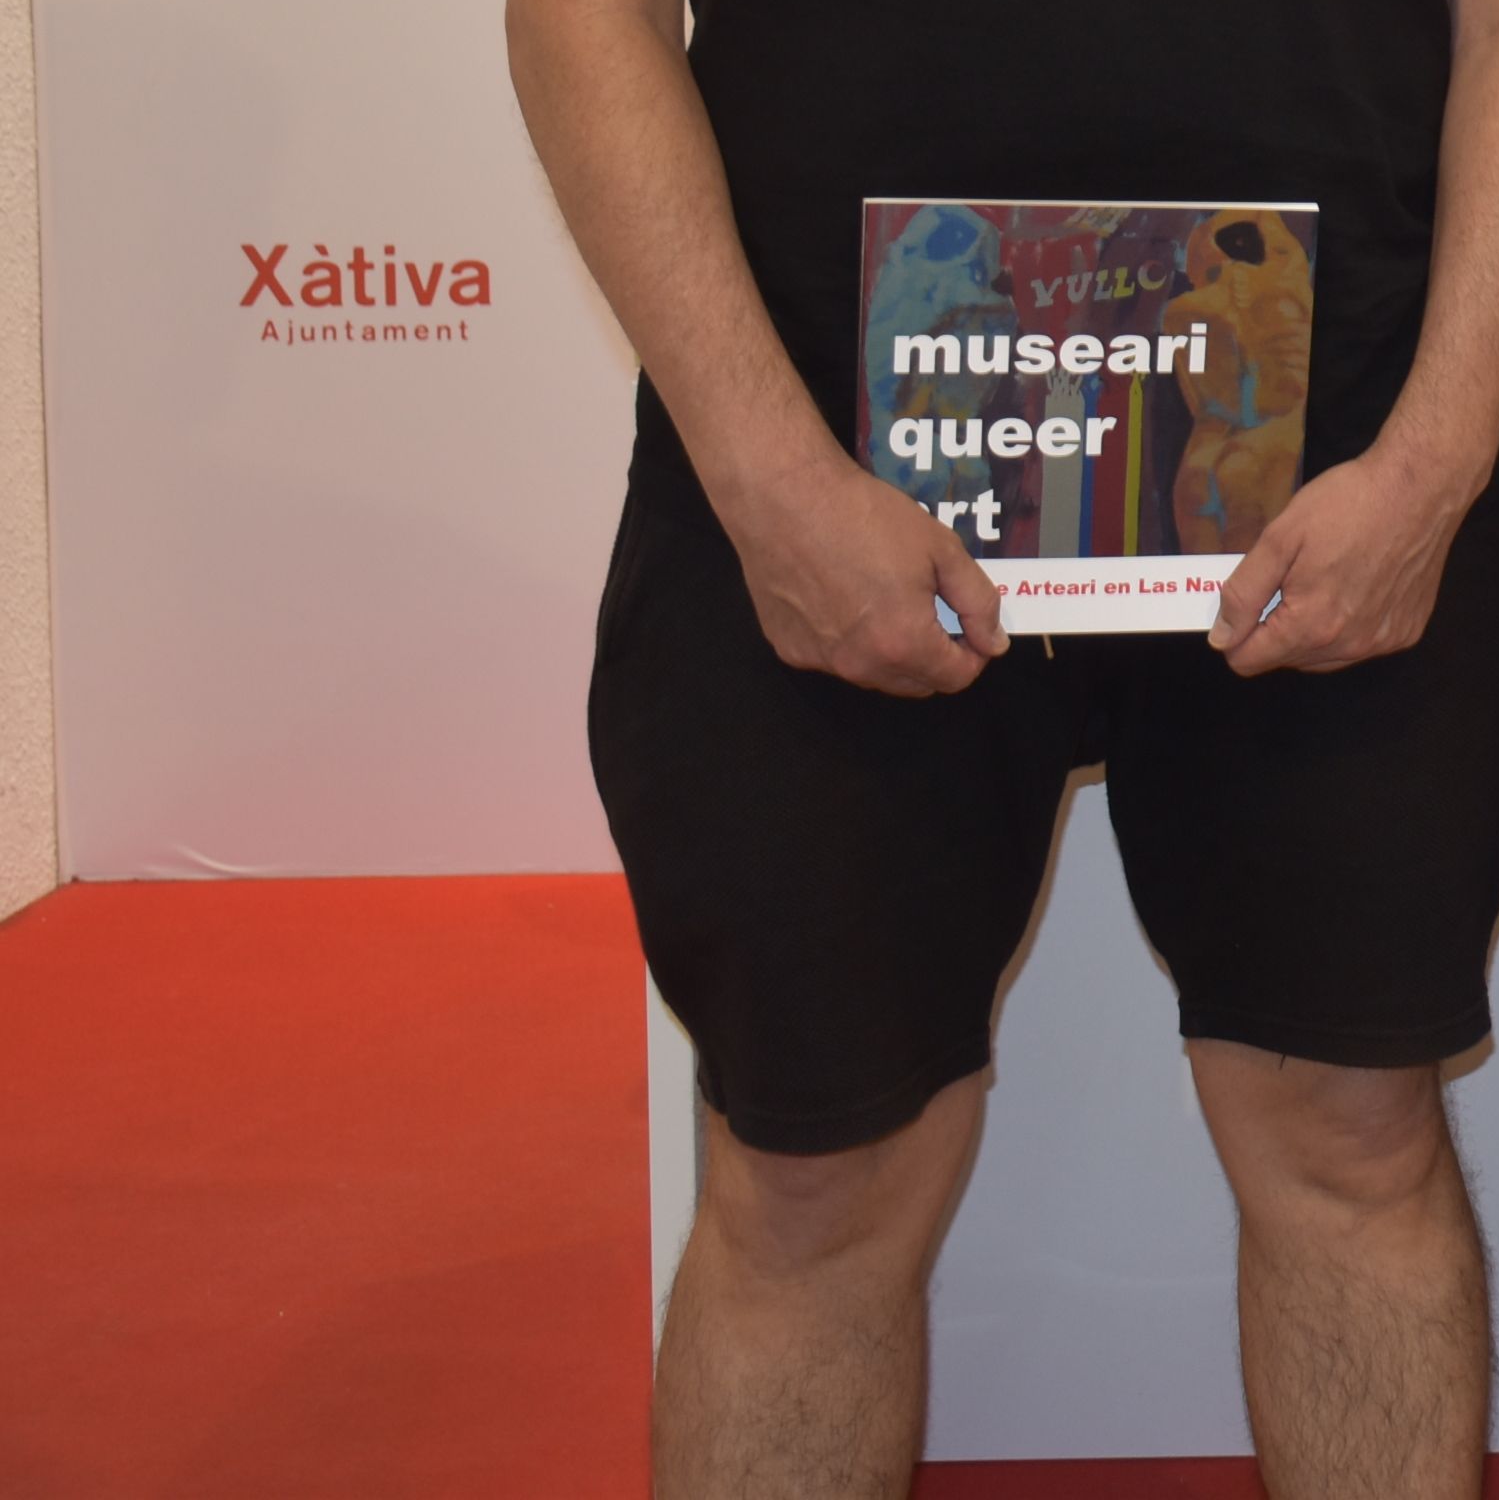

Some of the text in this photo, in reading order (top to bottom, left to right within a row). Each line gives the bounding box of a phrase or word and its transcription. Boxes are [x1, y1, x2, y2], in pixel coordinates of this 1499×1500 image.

[239, 244, 491, 307] Xàtiva
[261, 320, 469, 345] Ajuntament
[893, 322, 1208, 375] museari
[889, 417, 1117, 471] queer
[918, 489, 1001, 541] rt
[1016, 577, 1225, 596] Arteari en Las Nav
